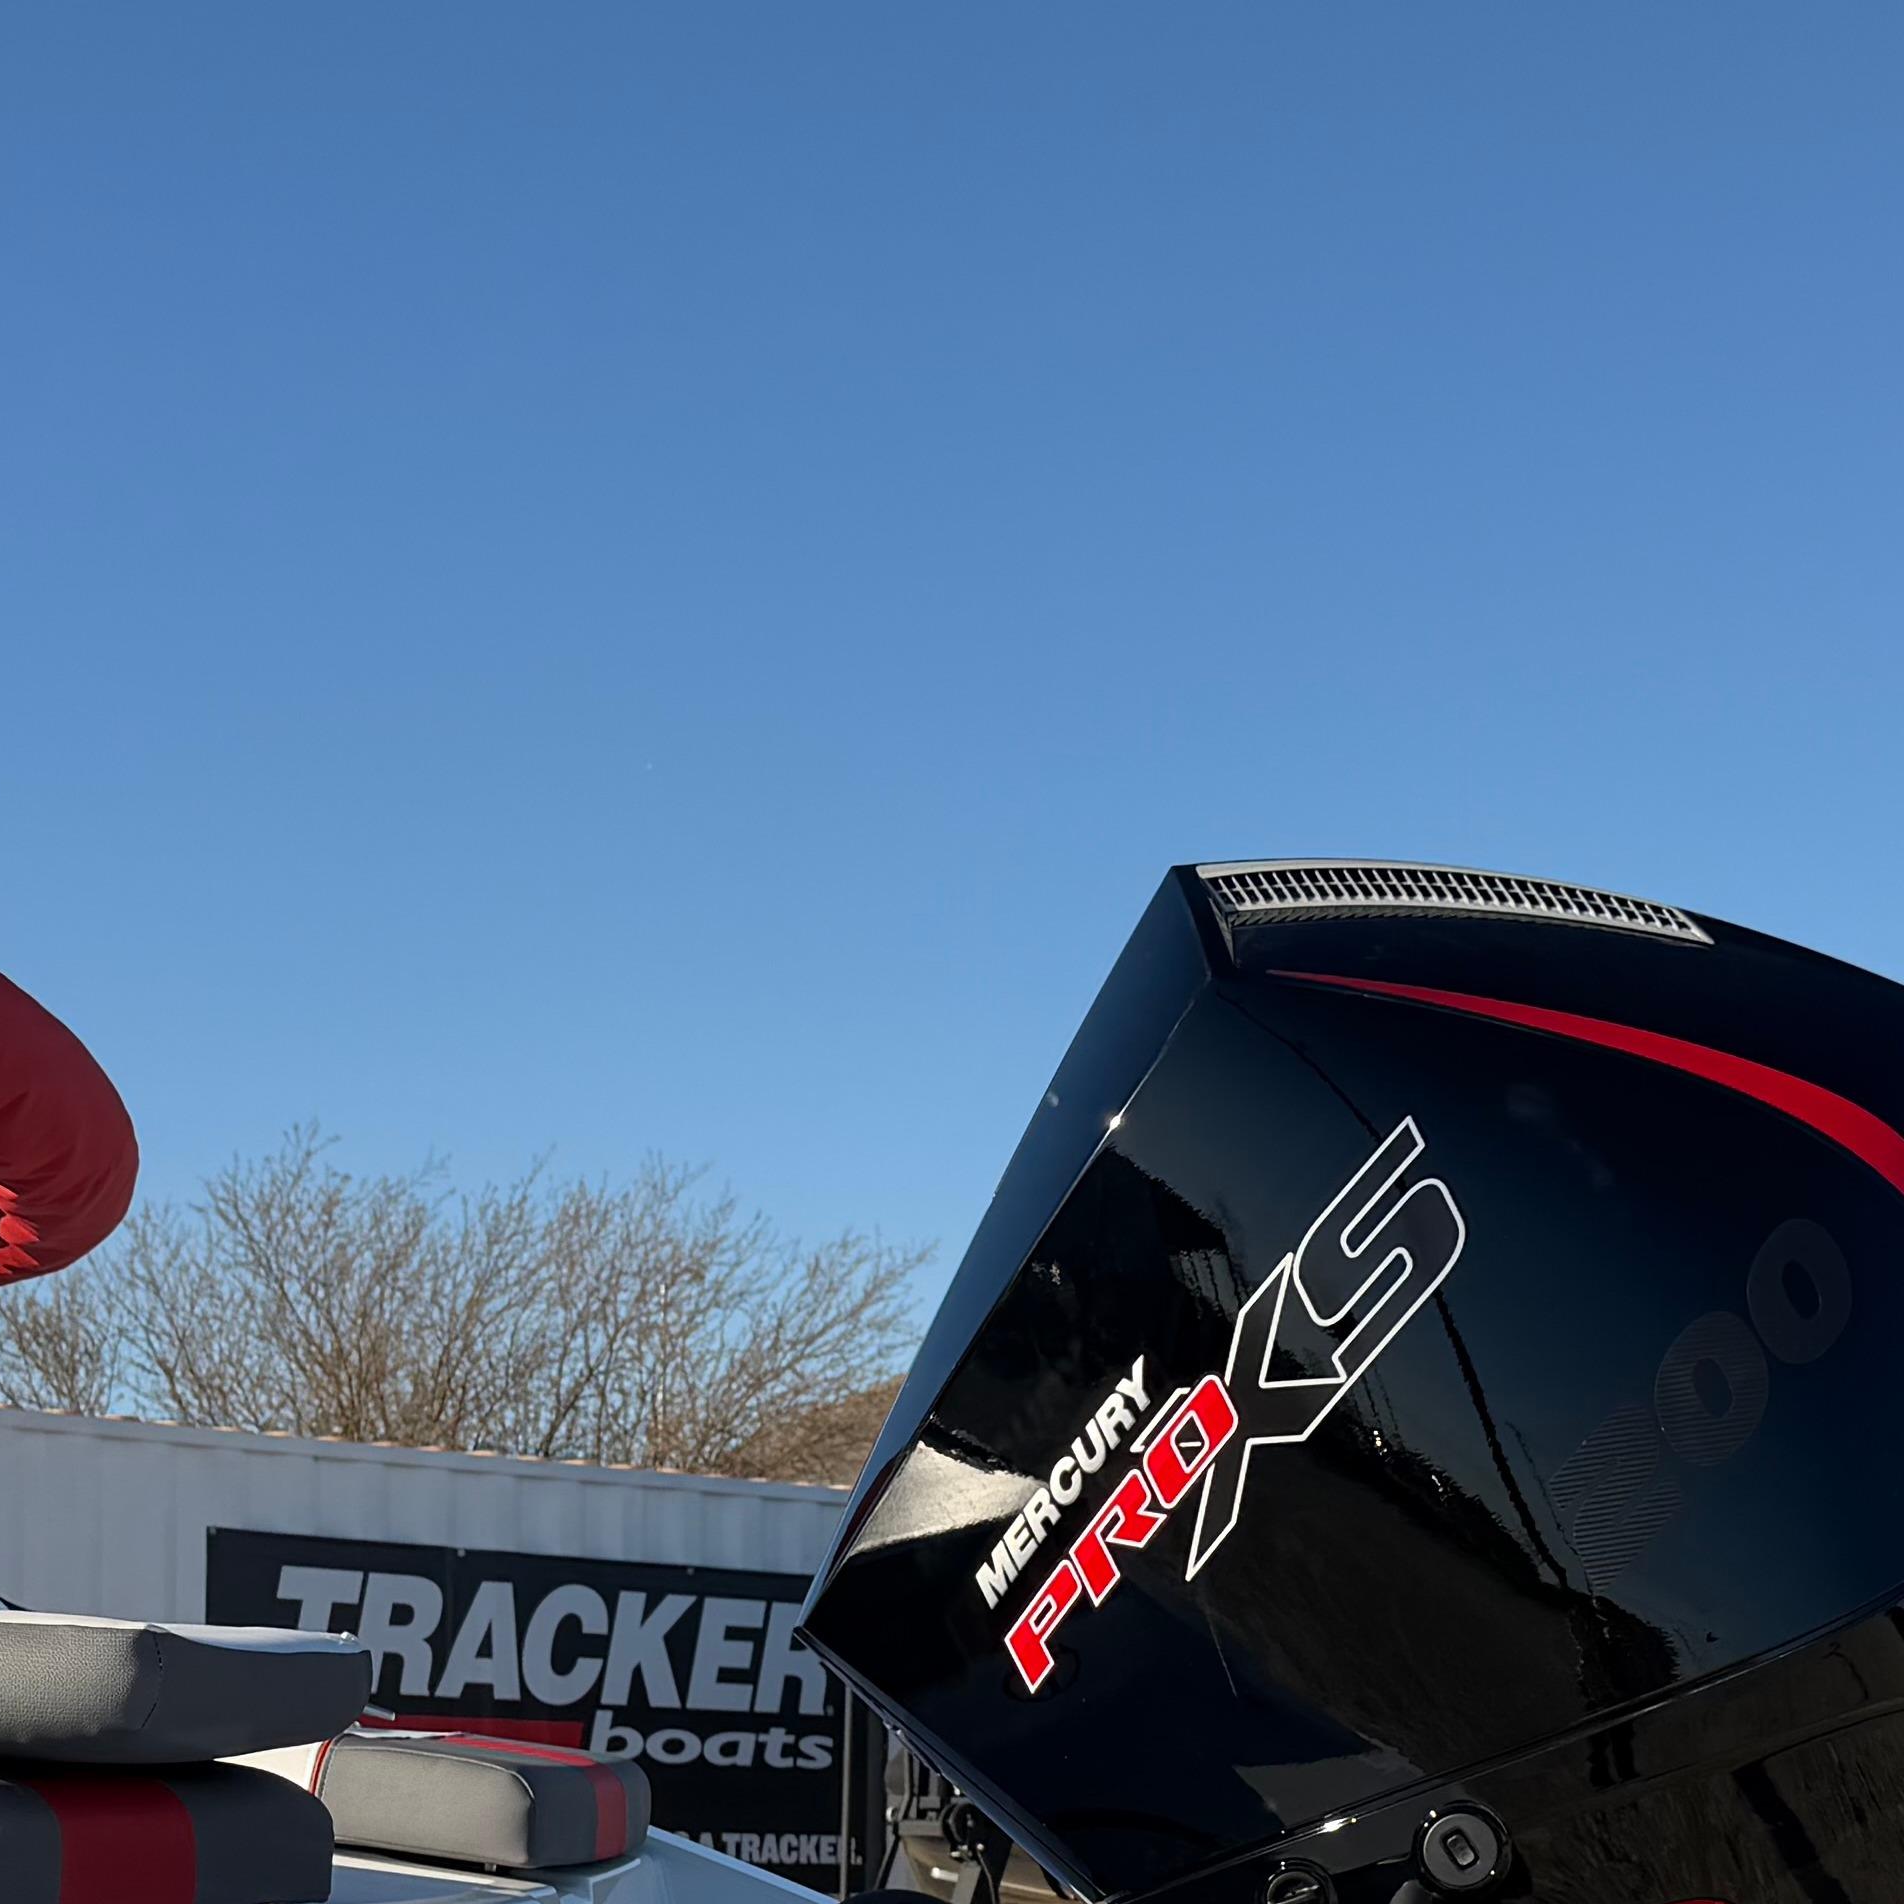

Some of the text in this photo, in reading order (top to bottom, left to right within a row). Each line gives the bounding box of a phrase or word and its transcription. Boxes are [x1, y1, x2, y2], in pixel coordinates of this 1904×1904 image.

[975, 1354, 1151, 1610] MERCURY
[1004, 1115, 1466, 1693] PRO XS
[587, 1709, 834, 1770] boats
